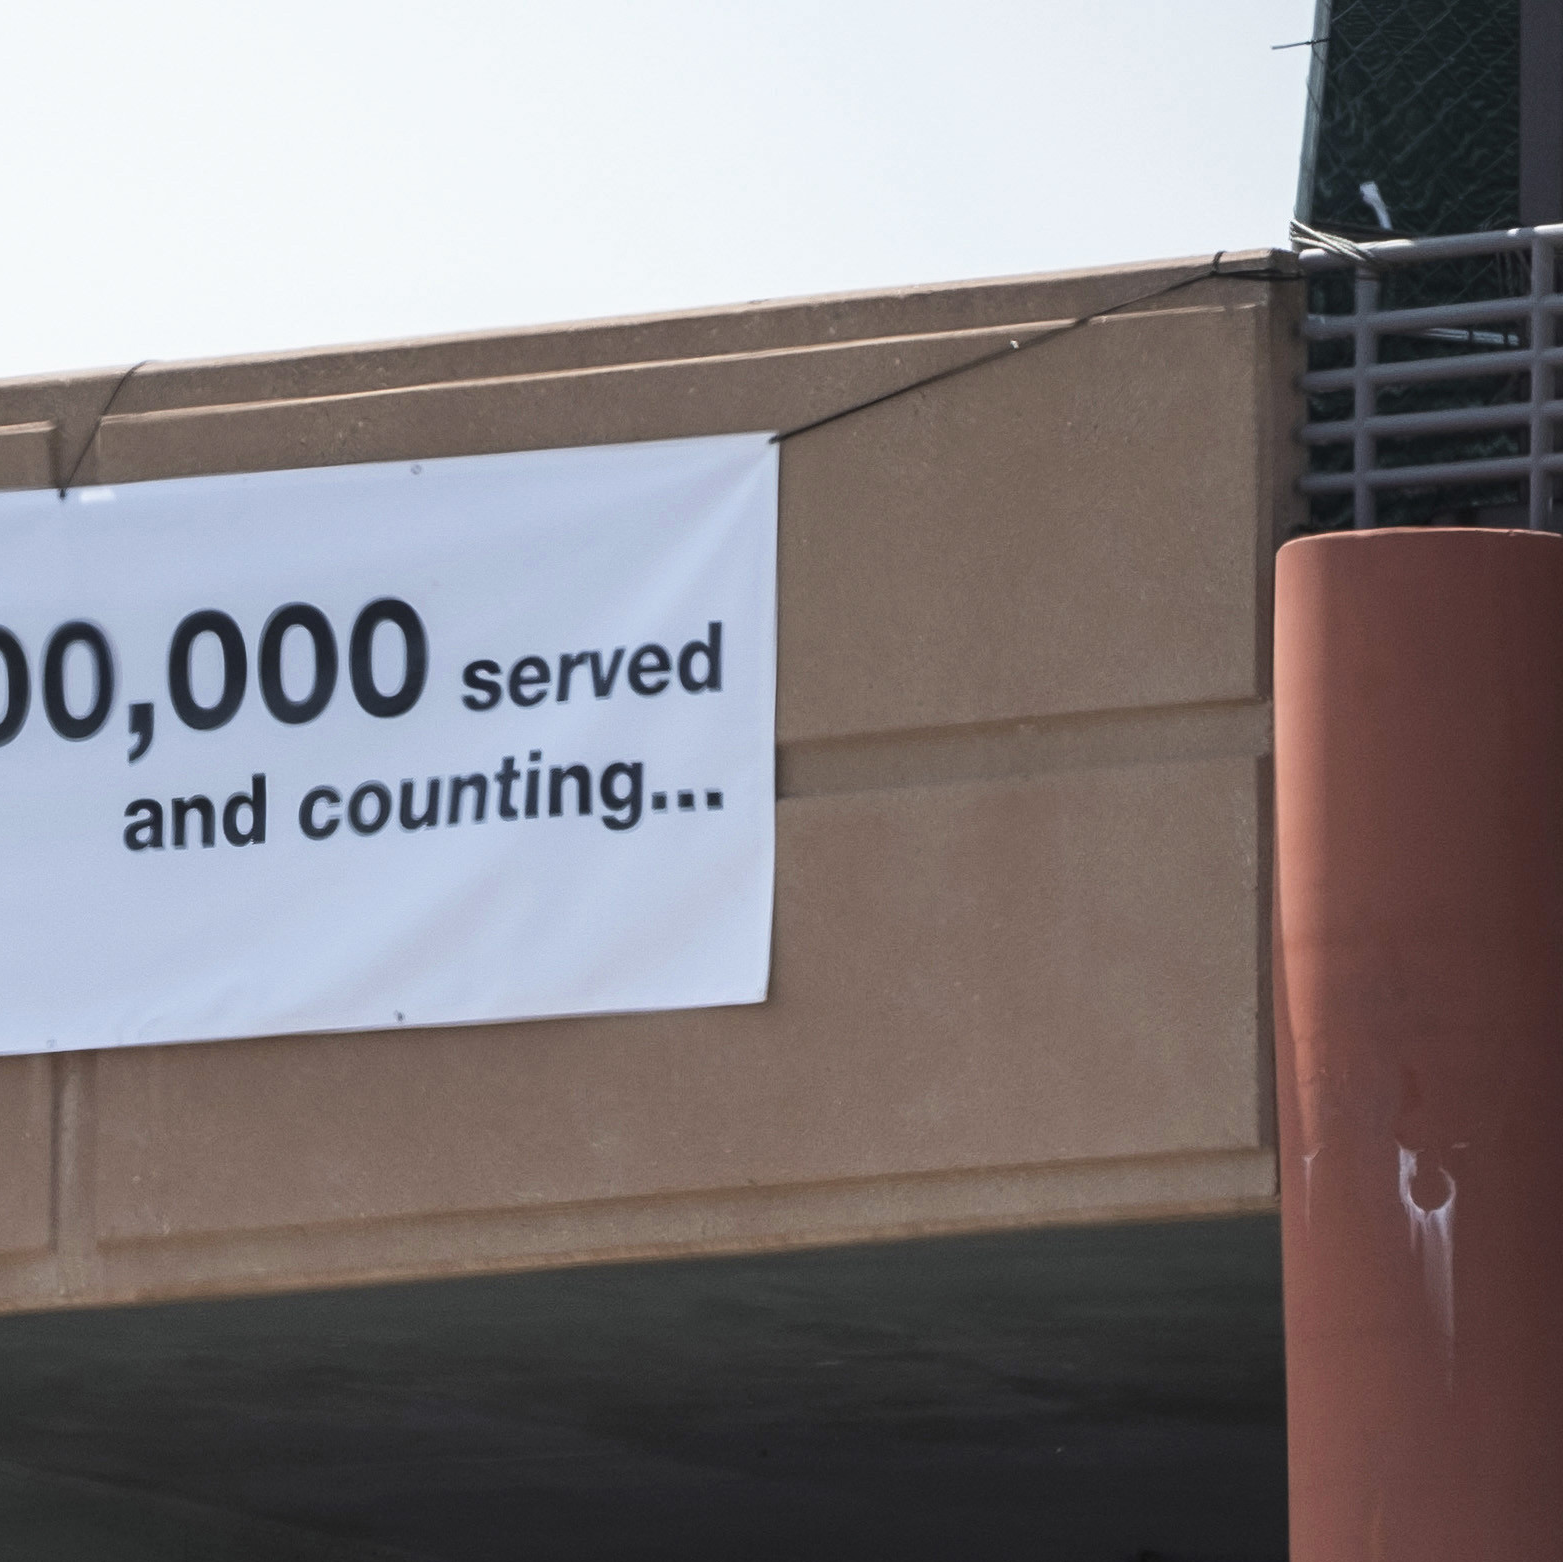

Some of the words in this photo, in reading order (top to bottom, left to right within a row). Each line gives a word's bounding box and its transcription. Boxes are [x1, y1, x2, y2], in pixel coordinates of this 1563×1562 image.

[461, 620, 724, 713] served
[122, 771, 268, 853] and
[297, 749, 724, 842] counting...
